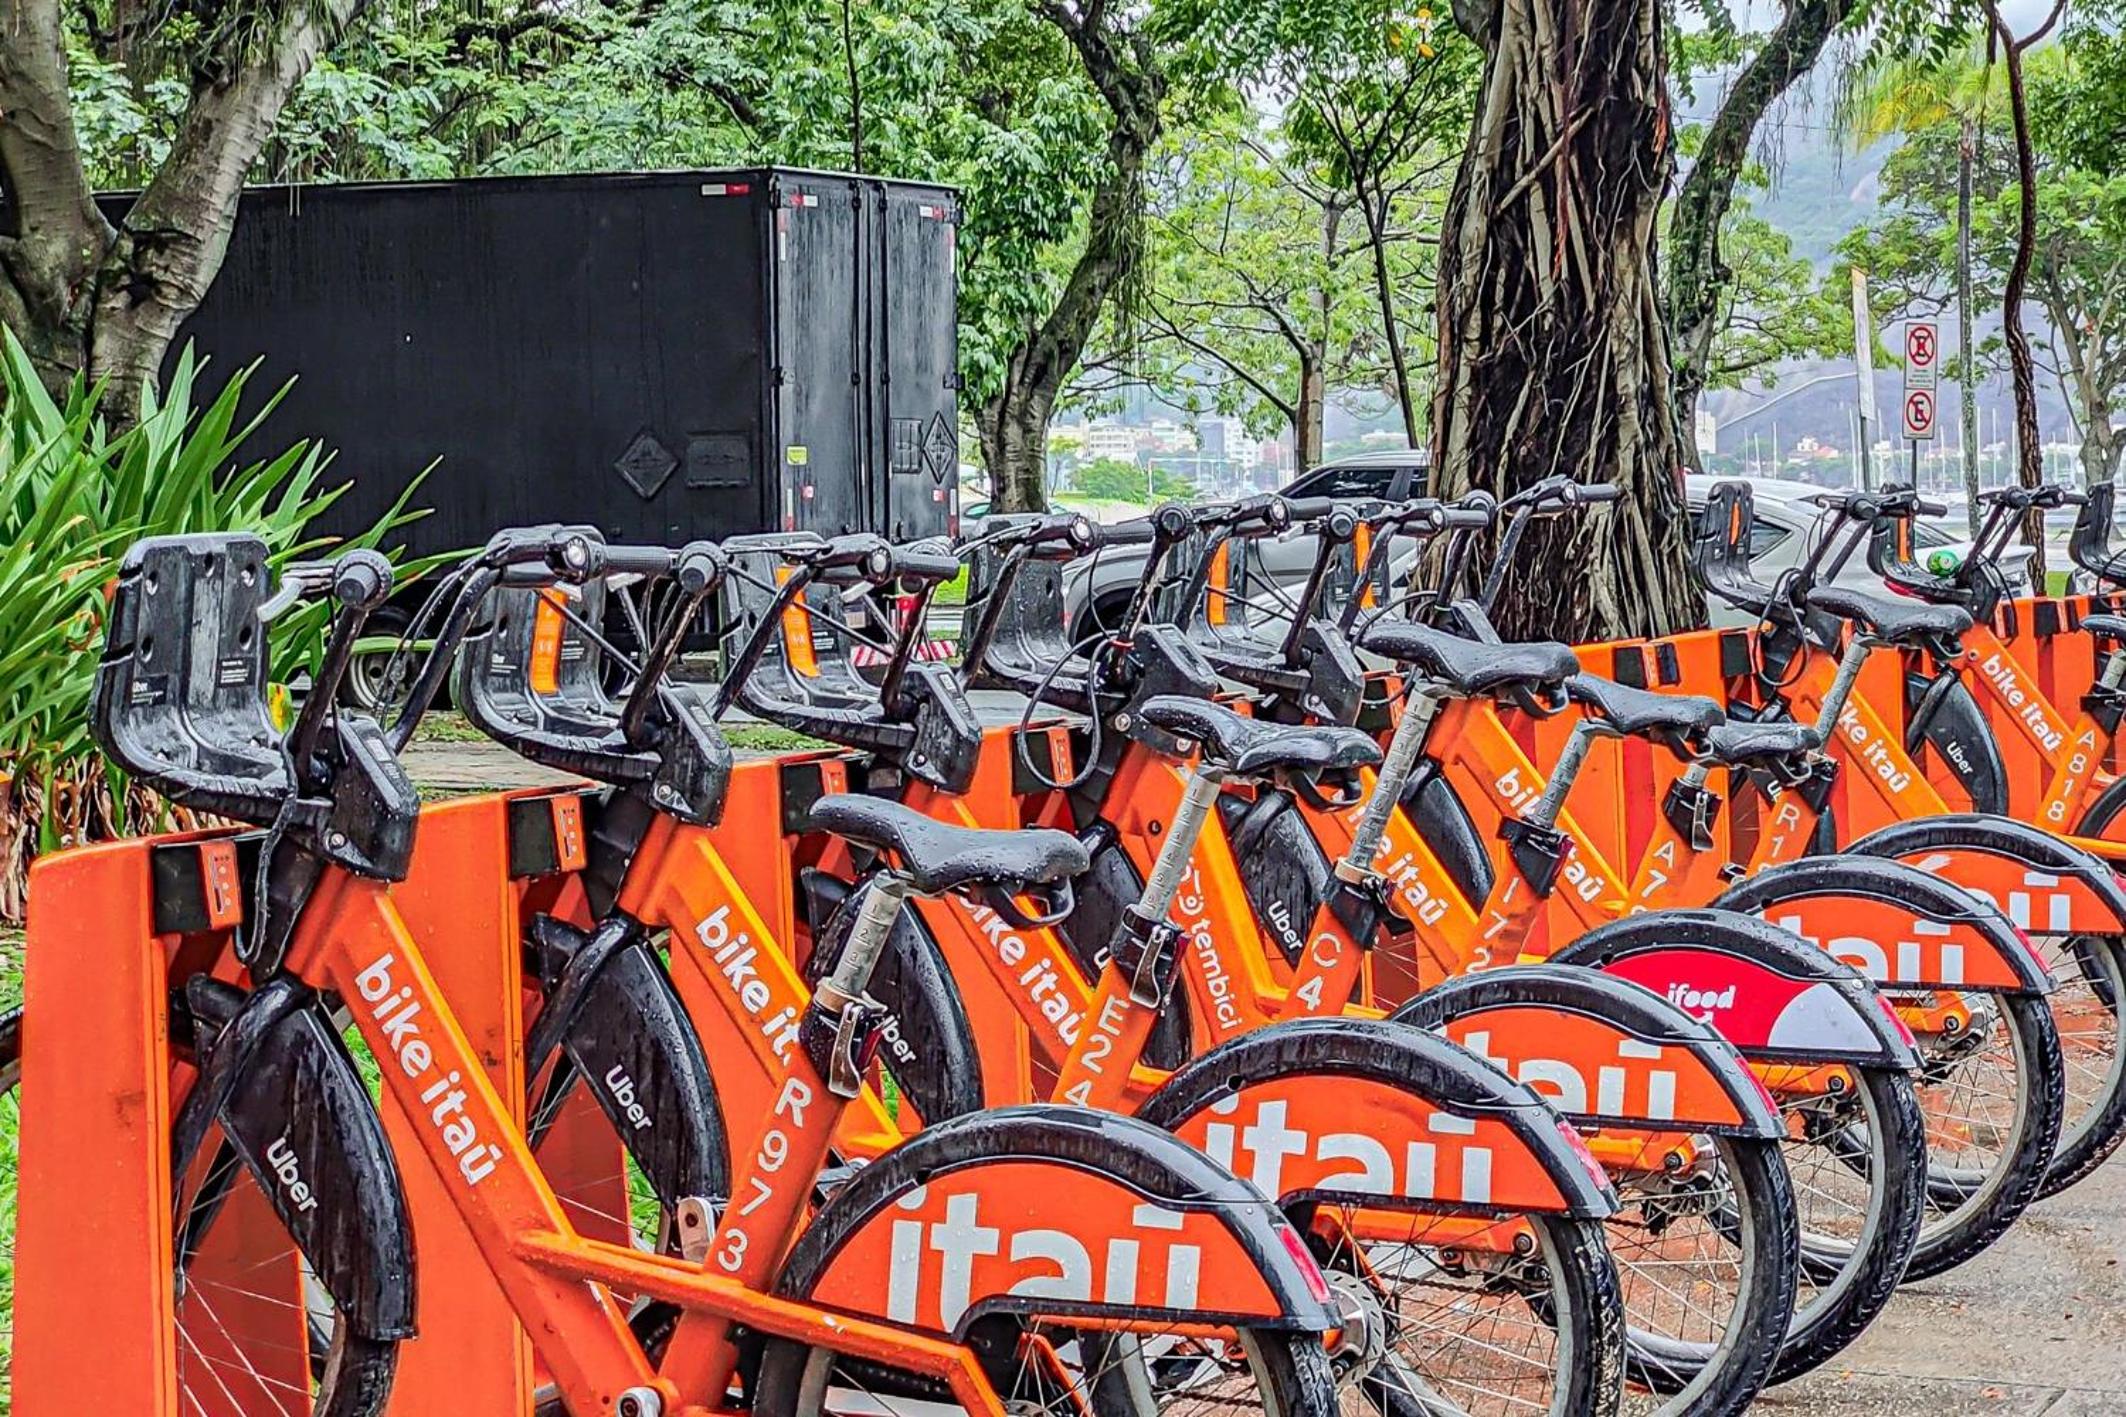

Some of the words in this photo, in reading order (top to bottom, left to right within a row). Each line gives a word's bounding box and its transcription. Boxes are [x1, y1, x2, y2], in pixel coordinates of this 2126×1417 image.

[1981, 653, 2025, 707] bike
[2020, 702, 2063, 751] itaú
[1863, 738, 1911, 794] itaú
[1946, 740, 1974, 775] Uber
[2047, 729, 2095, 822] A818
[1494, 766, 1542, 818] bik
[1564, 846, 1605, 903] aú
[1267, 899, 1304, 951] Uber
[1386, 852, 1450, 926] itaú
[695, 904, 771, 1015] bike
[761, 1006, 802, 1068] it
[1019, 957, 1087, 1047] itaú
[1191, 917, 1244, 1030] tembici
[355, 952, 433, 1079] bike
[420, 1070, 504, 1186] itaú
[605, 1063, 653, 1131] Uber
[265, 1136, 319, 1213] Uber
[717, 1076, 813, 1272] R973
[886, 1184, 1201, 1334] itaú
